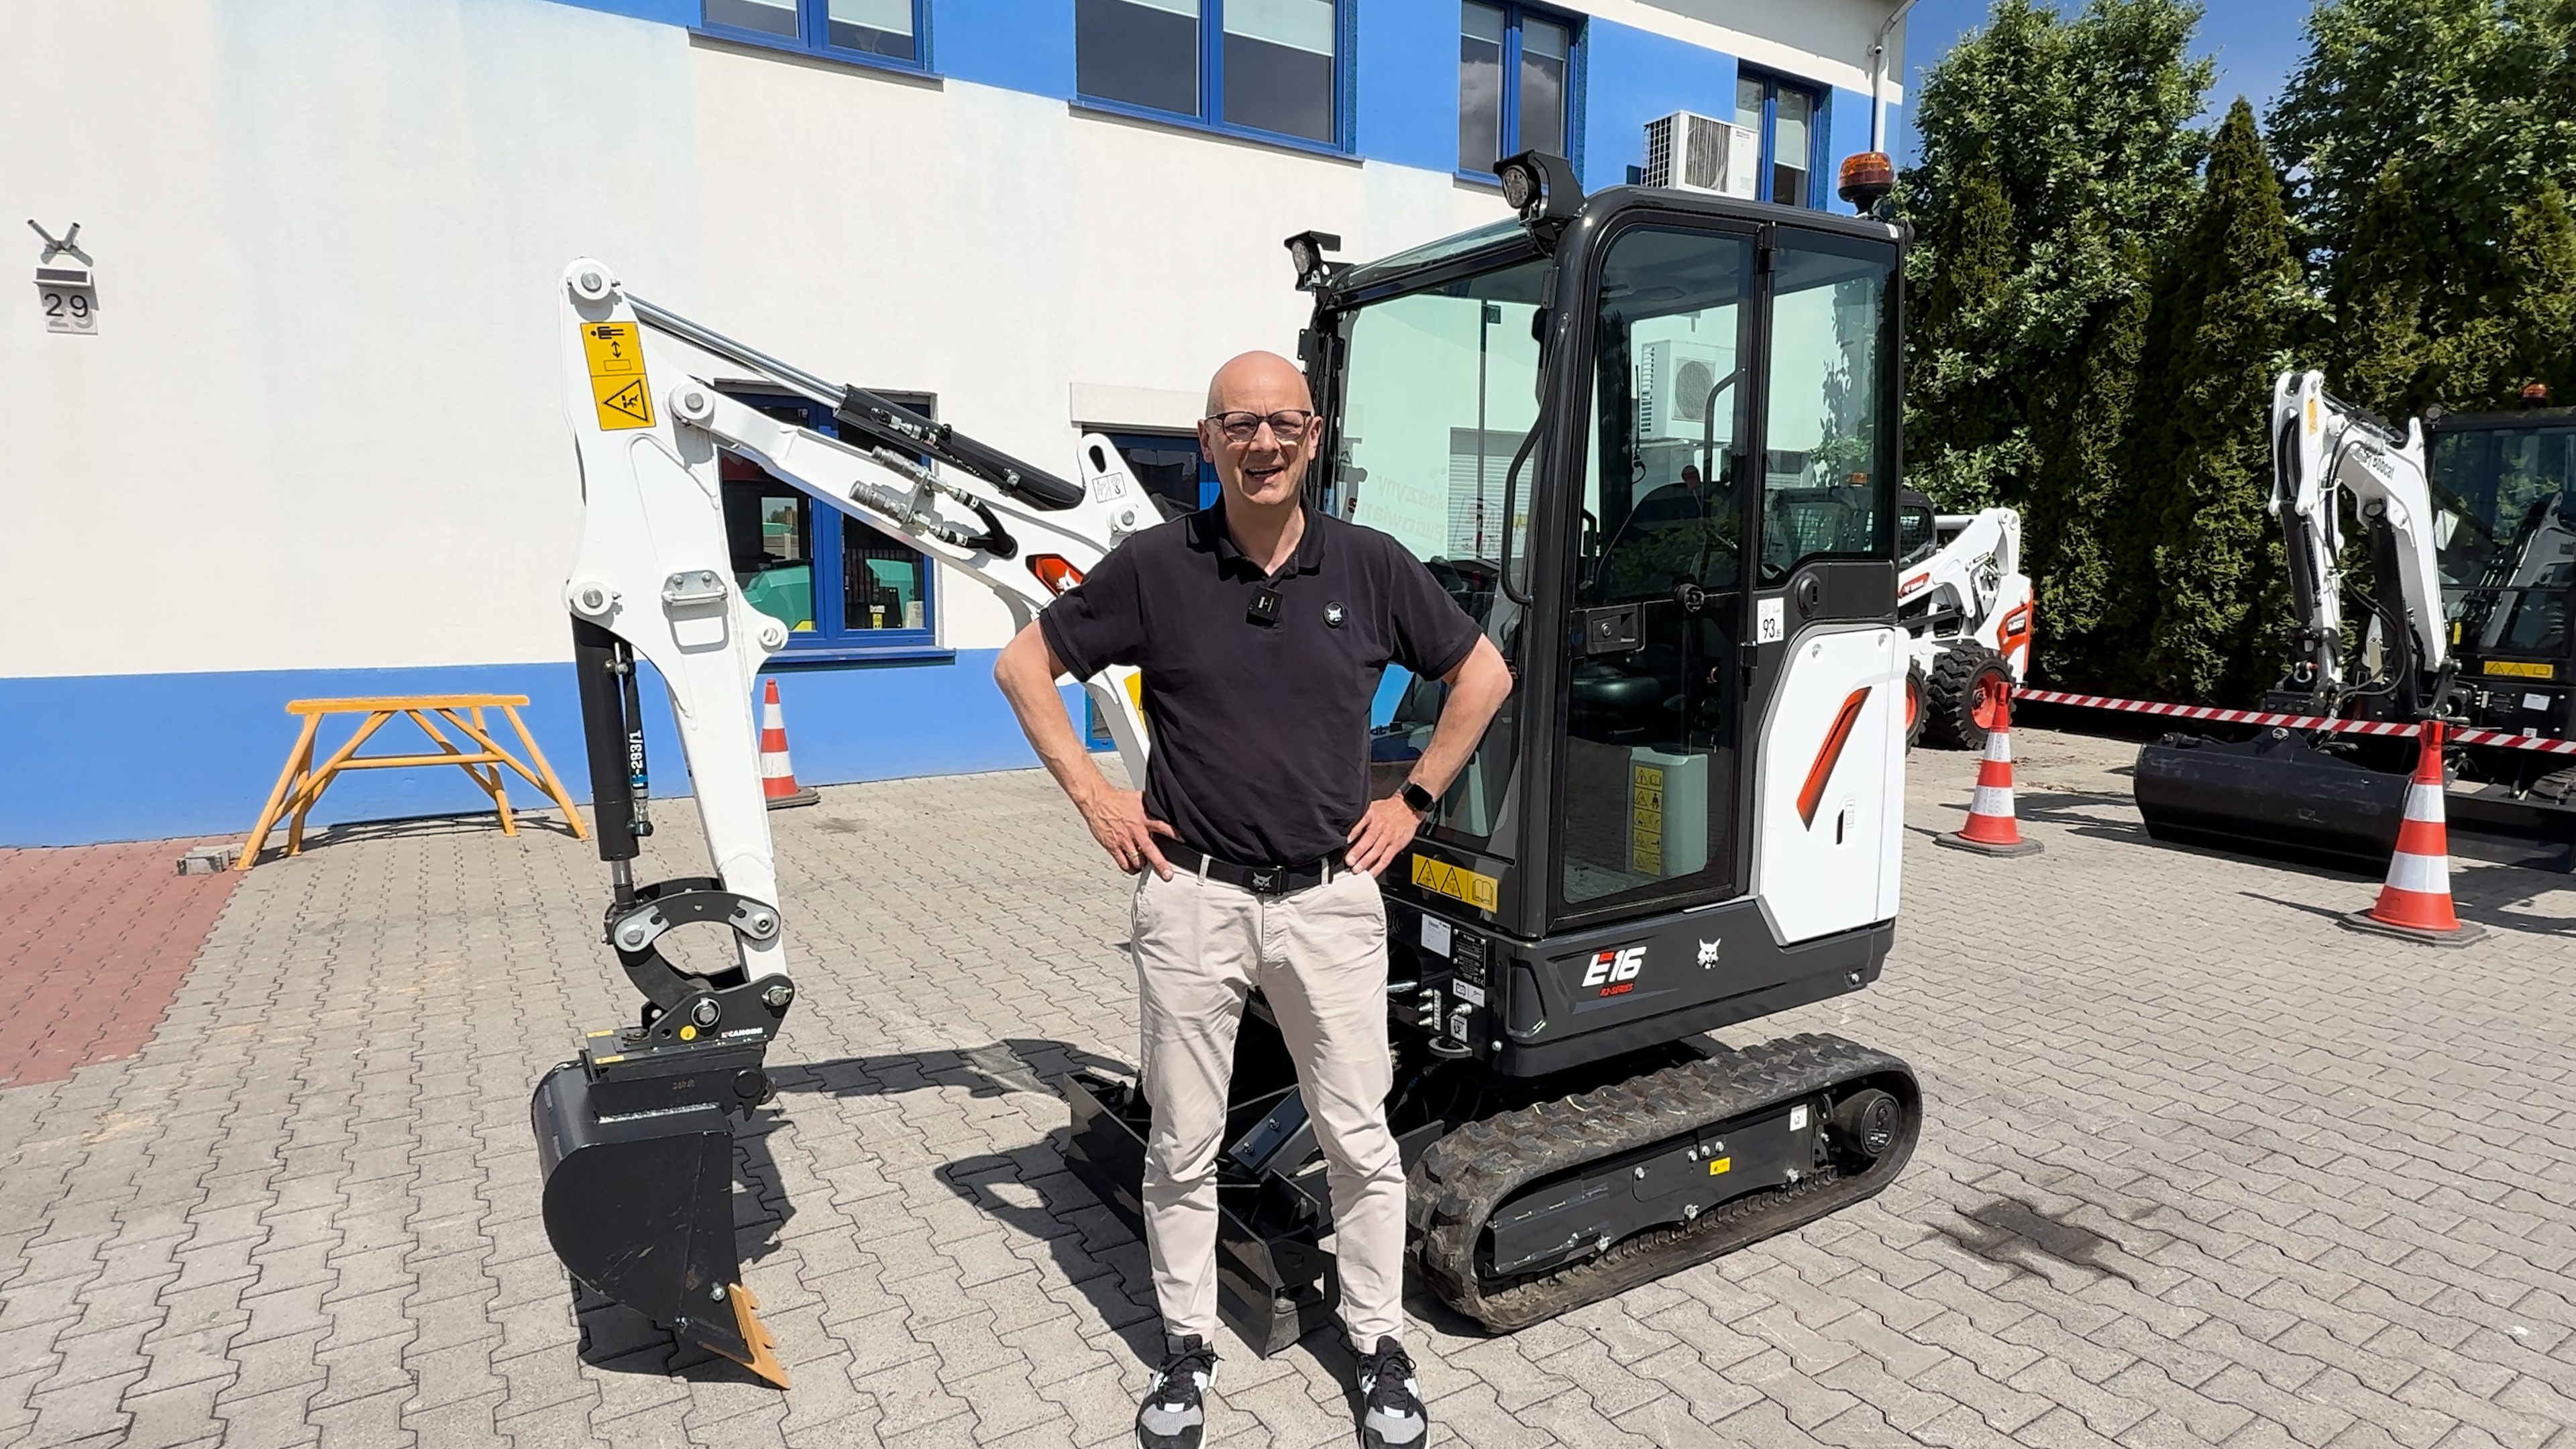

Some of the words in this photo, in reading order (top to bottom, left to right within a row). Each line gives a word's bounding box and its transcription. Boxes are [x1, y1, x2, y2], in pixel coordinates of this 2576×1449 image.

[44, 292, 89, 318] 29
[1763, 618, 1775, 639] 93
[1581, 946, 1648, 987] E16
